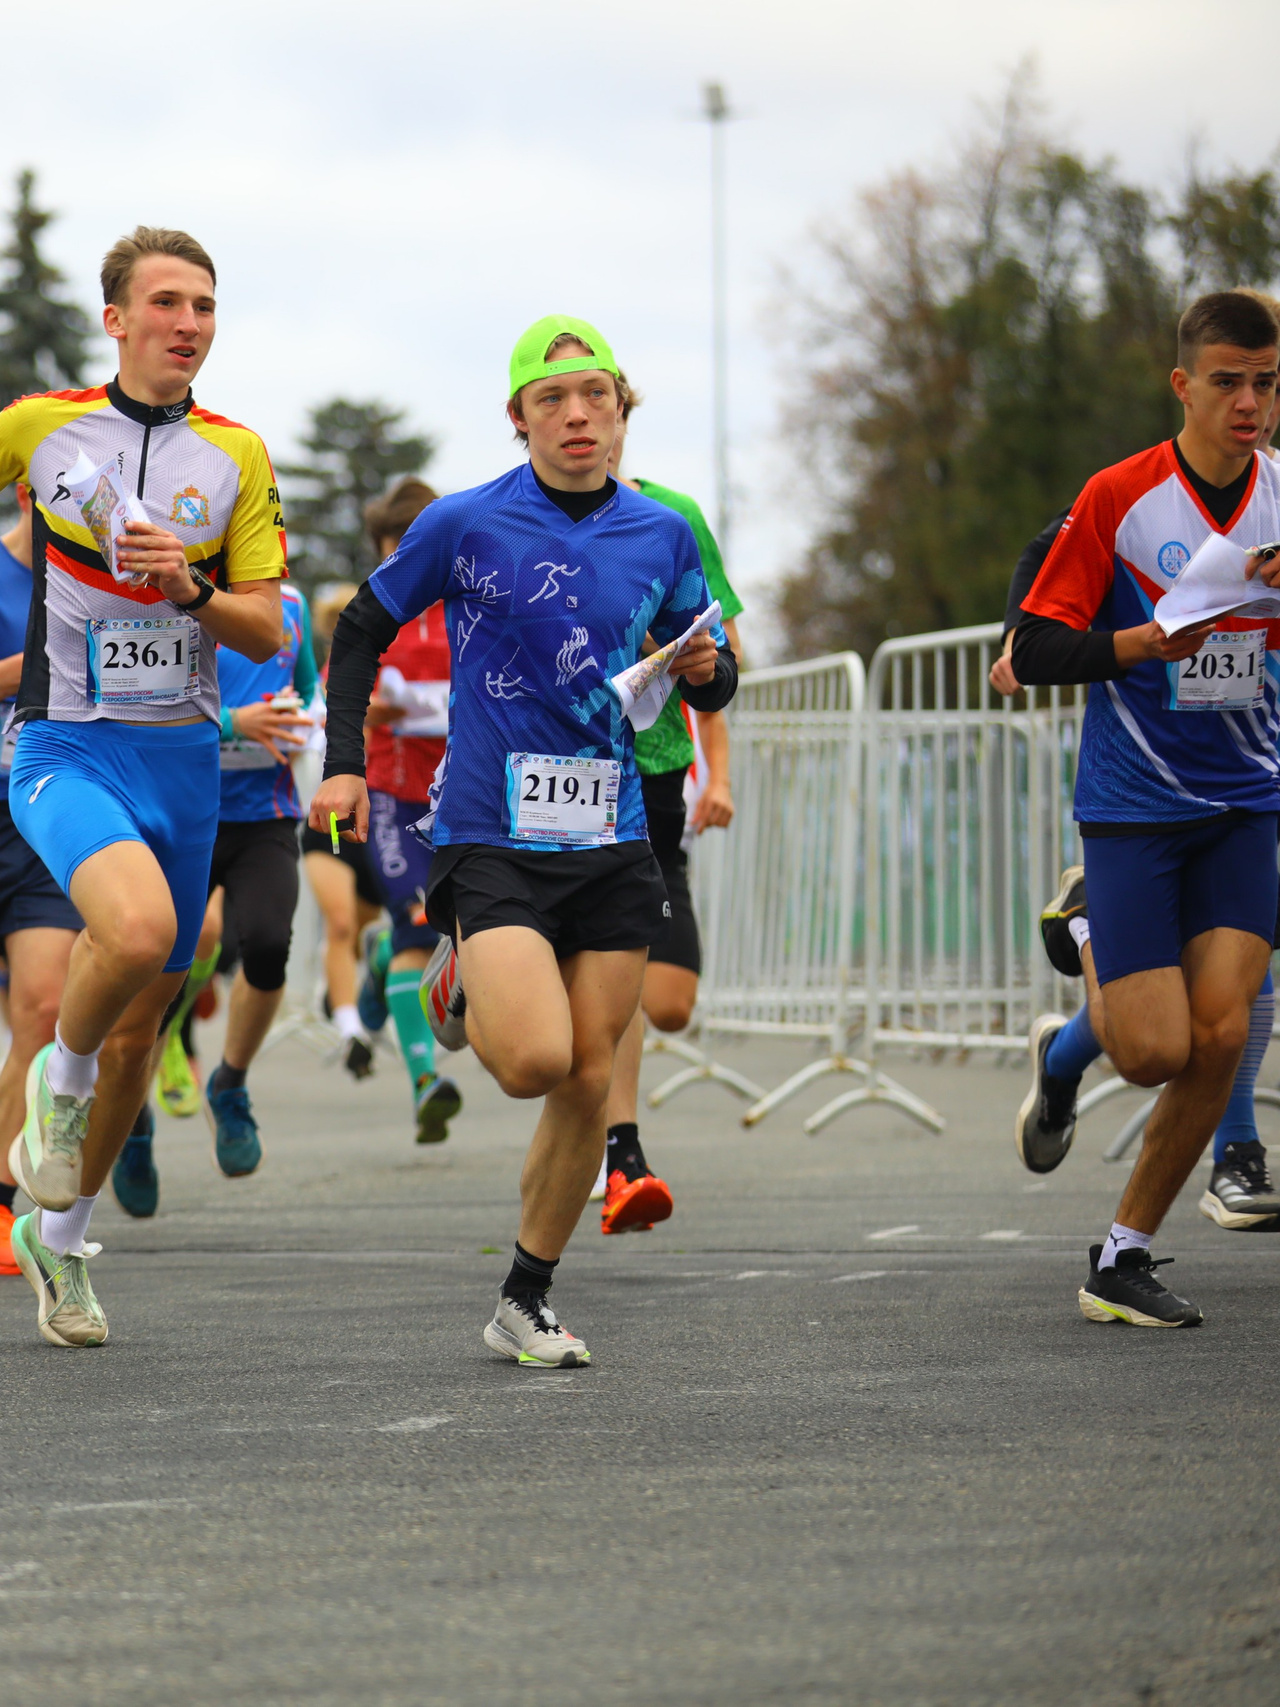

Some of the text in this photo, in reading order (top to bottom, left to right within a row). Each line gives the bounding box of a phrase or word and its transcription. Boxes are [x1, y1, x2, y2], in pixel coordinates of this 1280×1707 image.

[103, 639, 185, 669] 236.1
[1181, 651, 1255, 679] 203.1
[522, 773, 601, 806] 219.1
